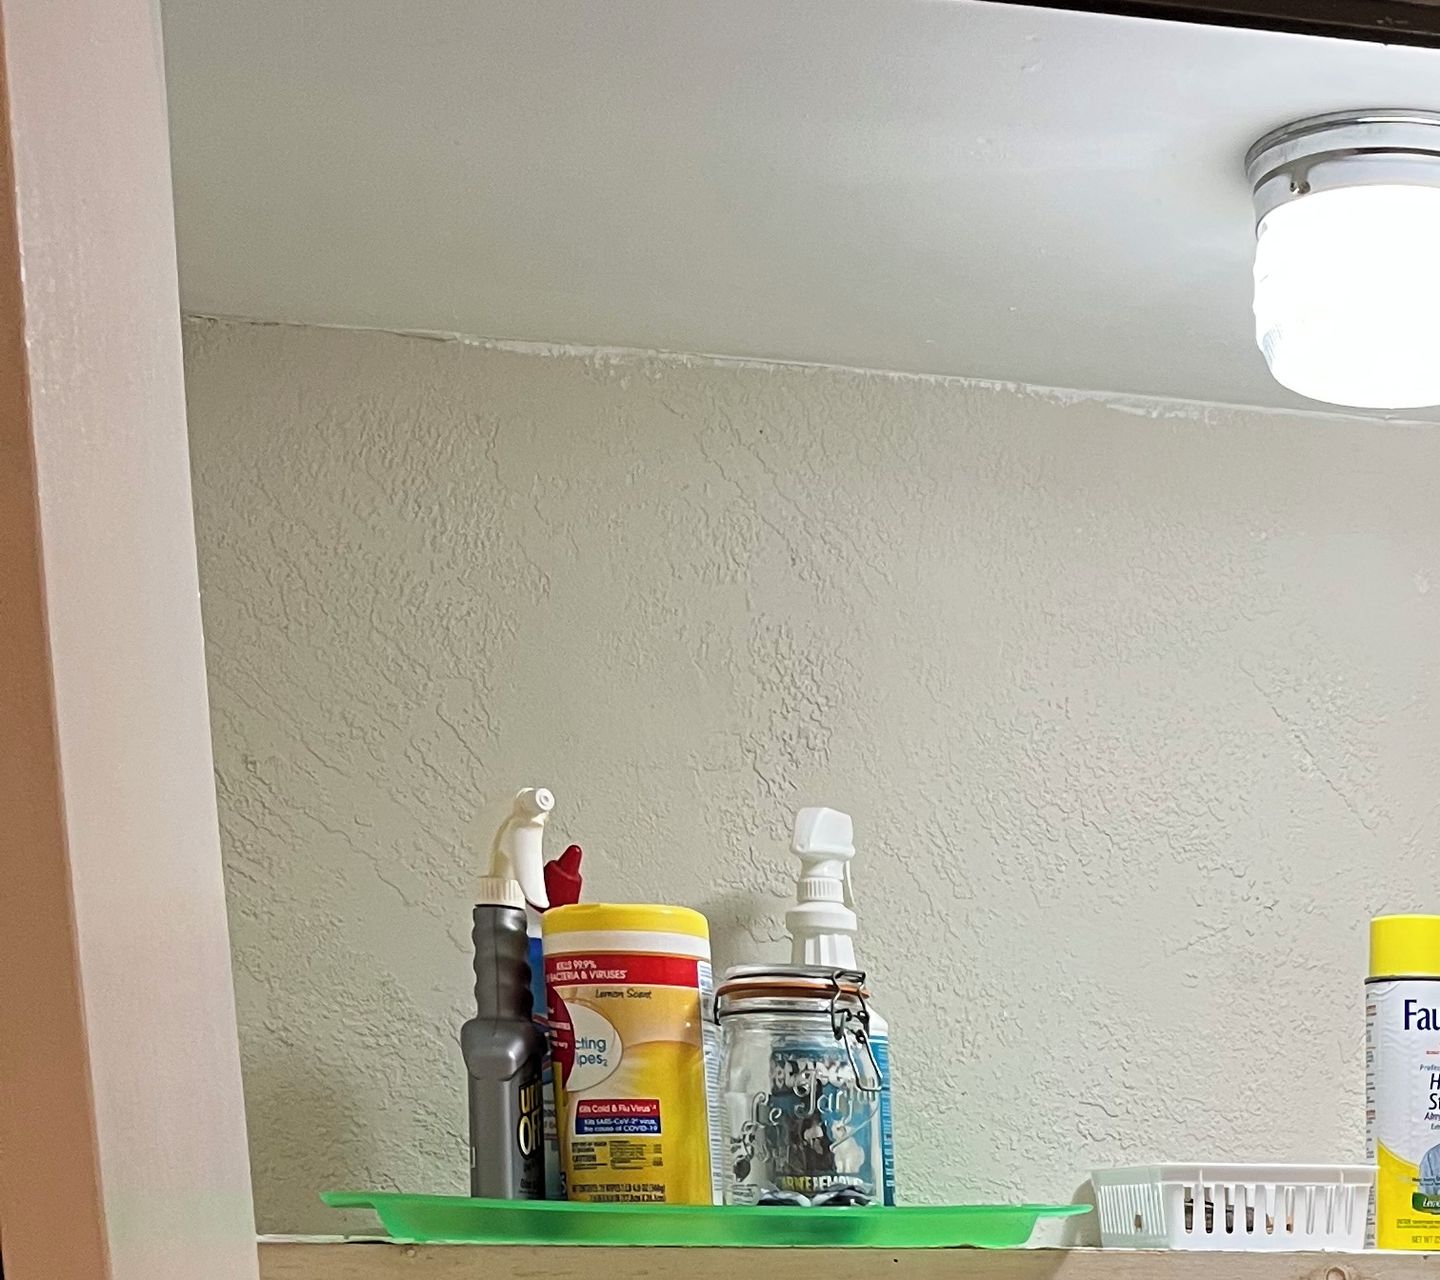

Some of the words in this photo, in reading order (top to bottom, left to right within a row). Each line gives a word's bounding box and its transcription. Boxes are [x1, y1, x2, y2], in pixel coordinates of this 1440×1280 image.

[595, 989, 624, 999] Lemon
[626, 988, 652, 1000] Scent
[592, 1104, 610, 1113] Cold
[618, 1104, 630, 1112] Flu
